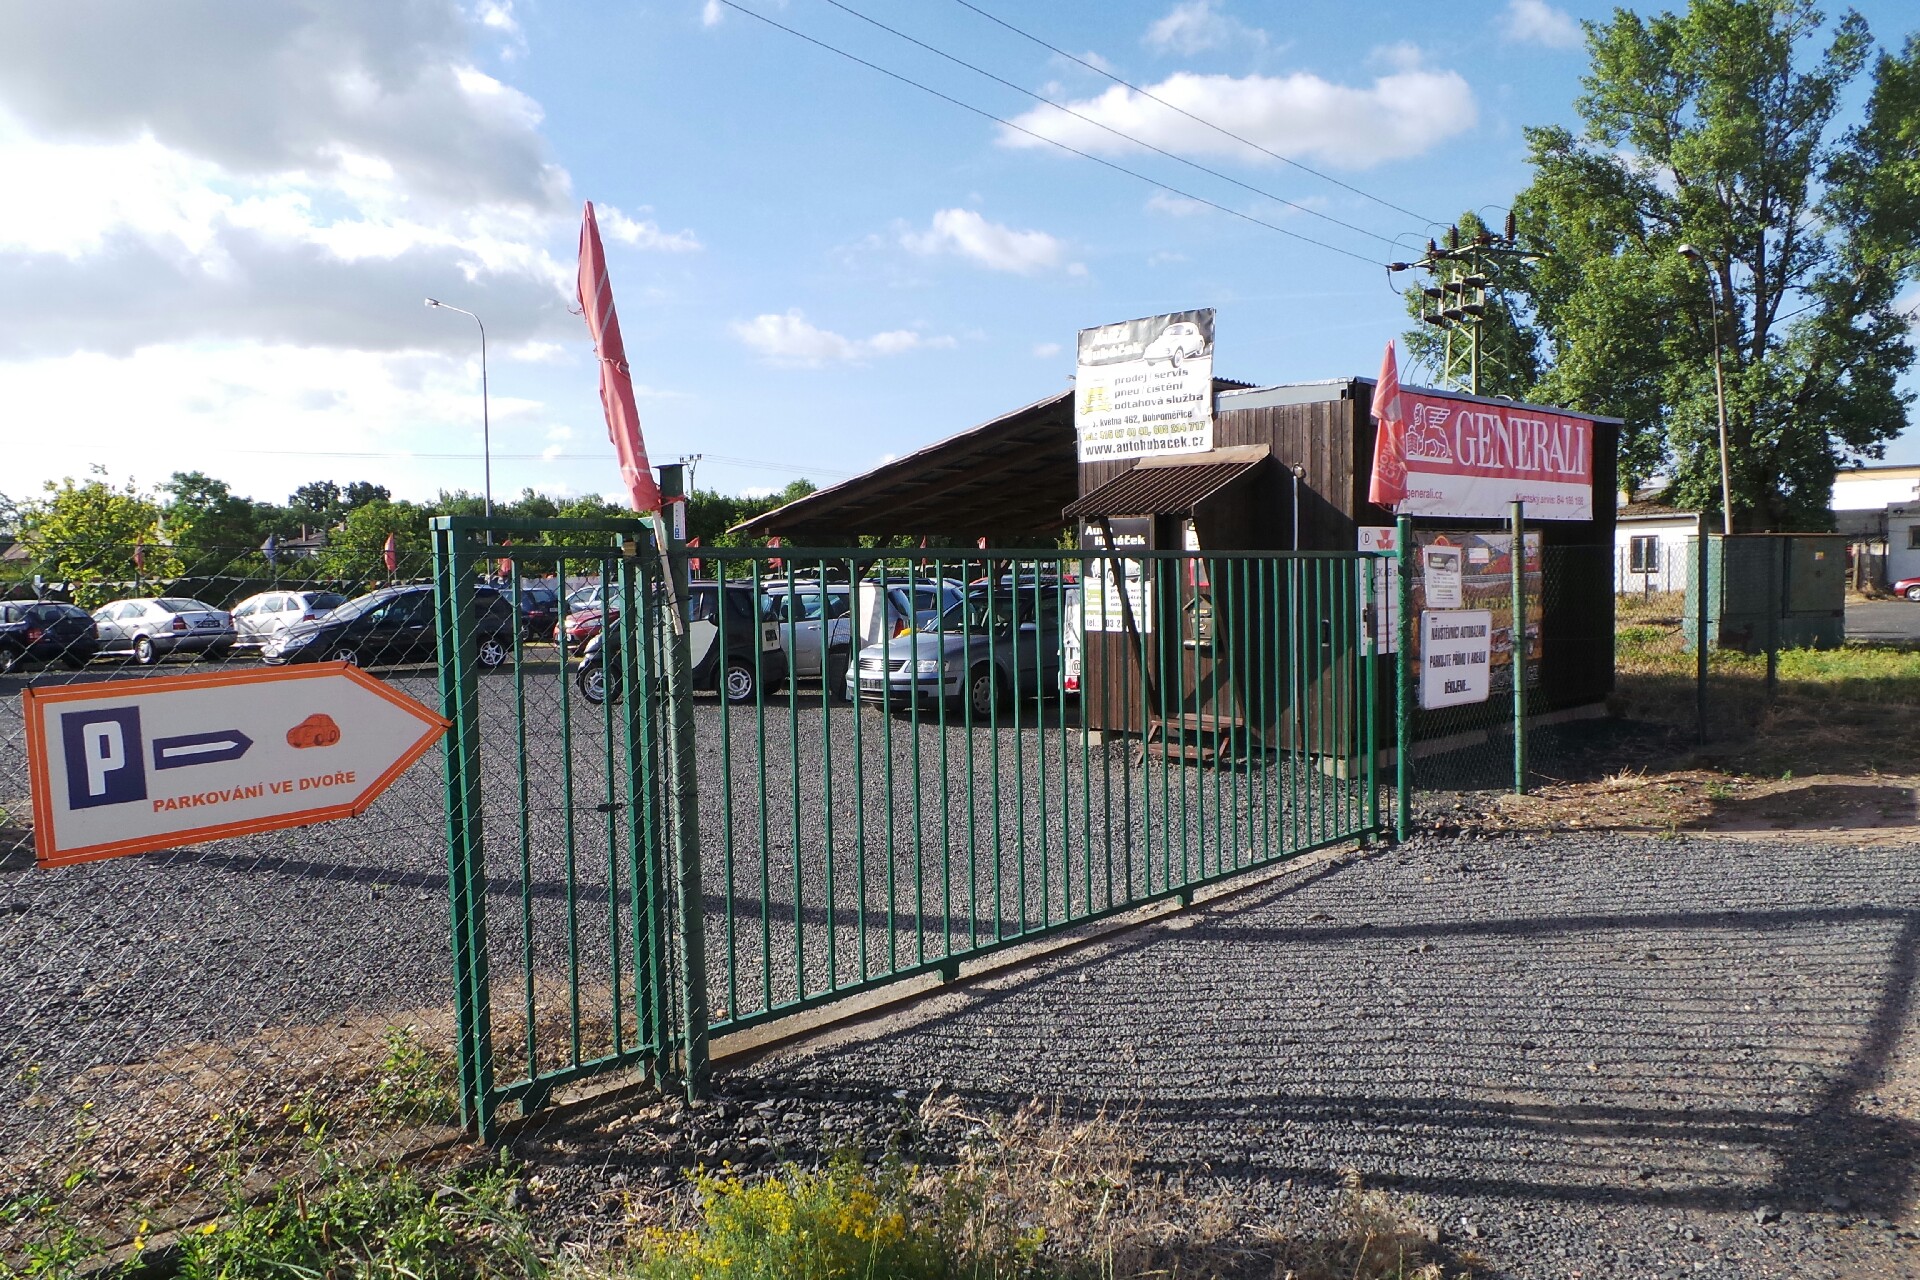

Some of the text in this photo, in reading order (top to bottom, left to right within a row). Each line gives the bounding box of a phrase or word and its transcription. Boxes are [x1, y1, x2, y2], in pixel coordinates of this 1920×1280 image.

[1114, 368, 1189, 386] prodej servis
[1114, 388, 1140, 399] pneu
[1114, 392, 1204, 410] odtahová služba
[1188, 420, 1206, 432] 717
[1085, 435, 1205, 456] www.autohubacek.cz
[1455, 410, 1585, 475] GENERALI
[1405, 487, 1443, 501] generali.cz
[83, 720, 126, 797] P
[152, 770, 357, 813] PARKOVÁNÍ VE DVOŘE
